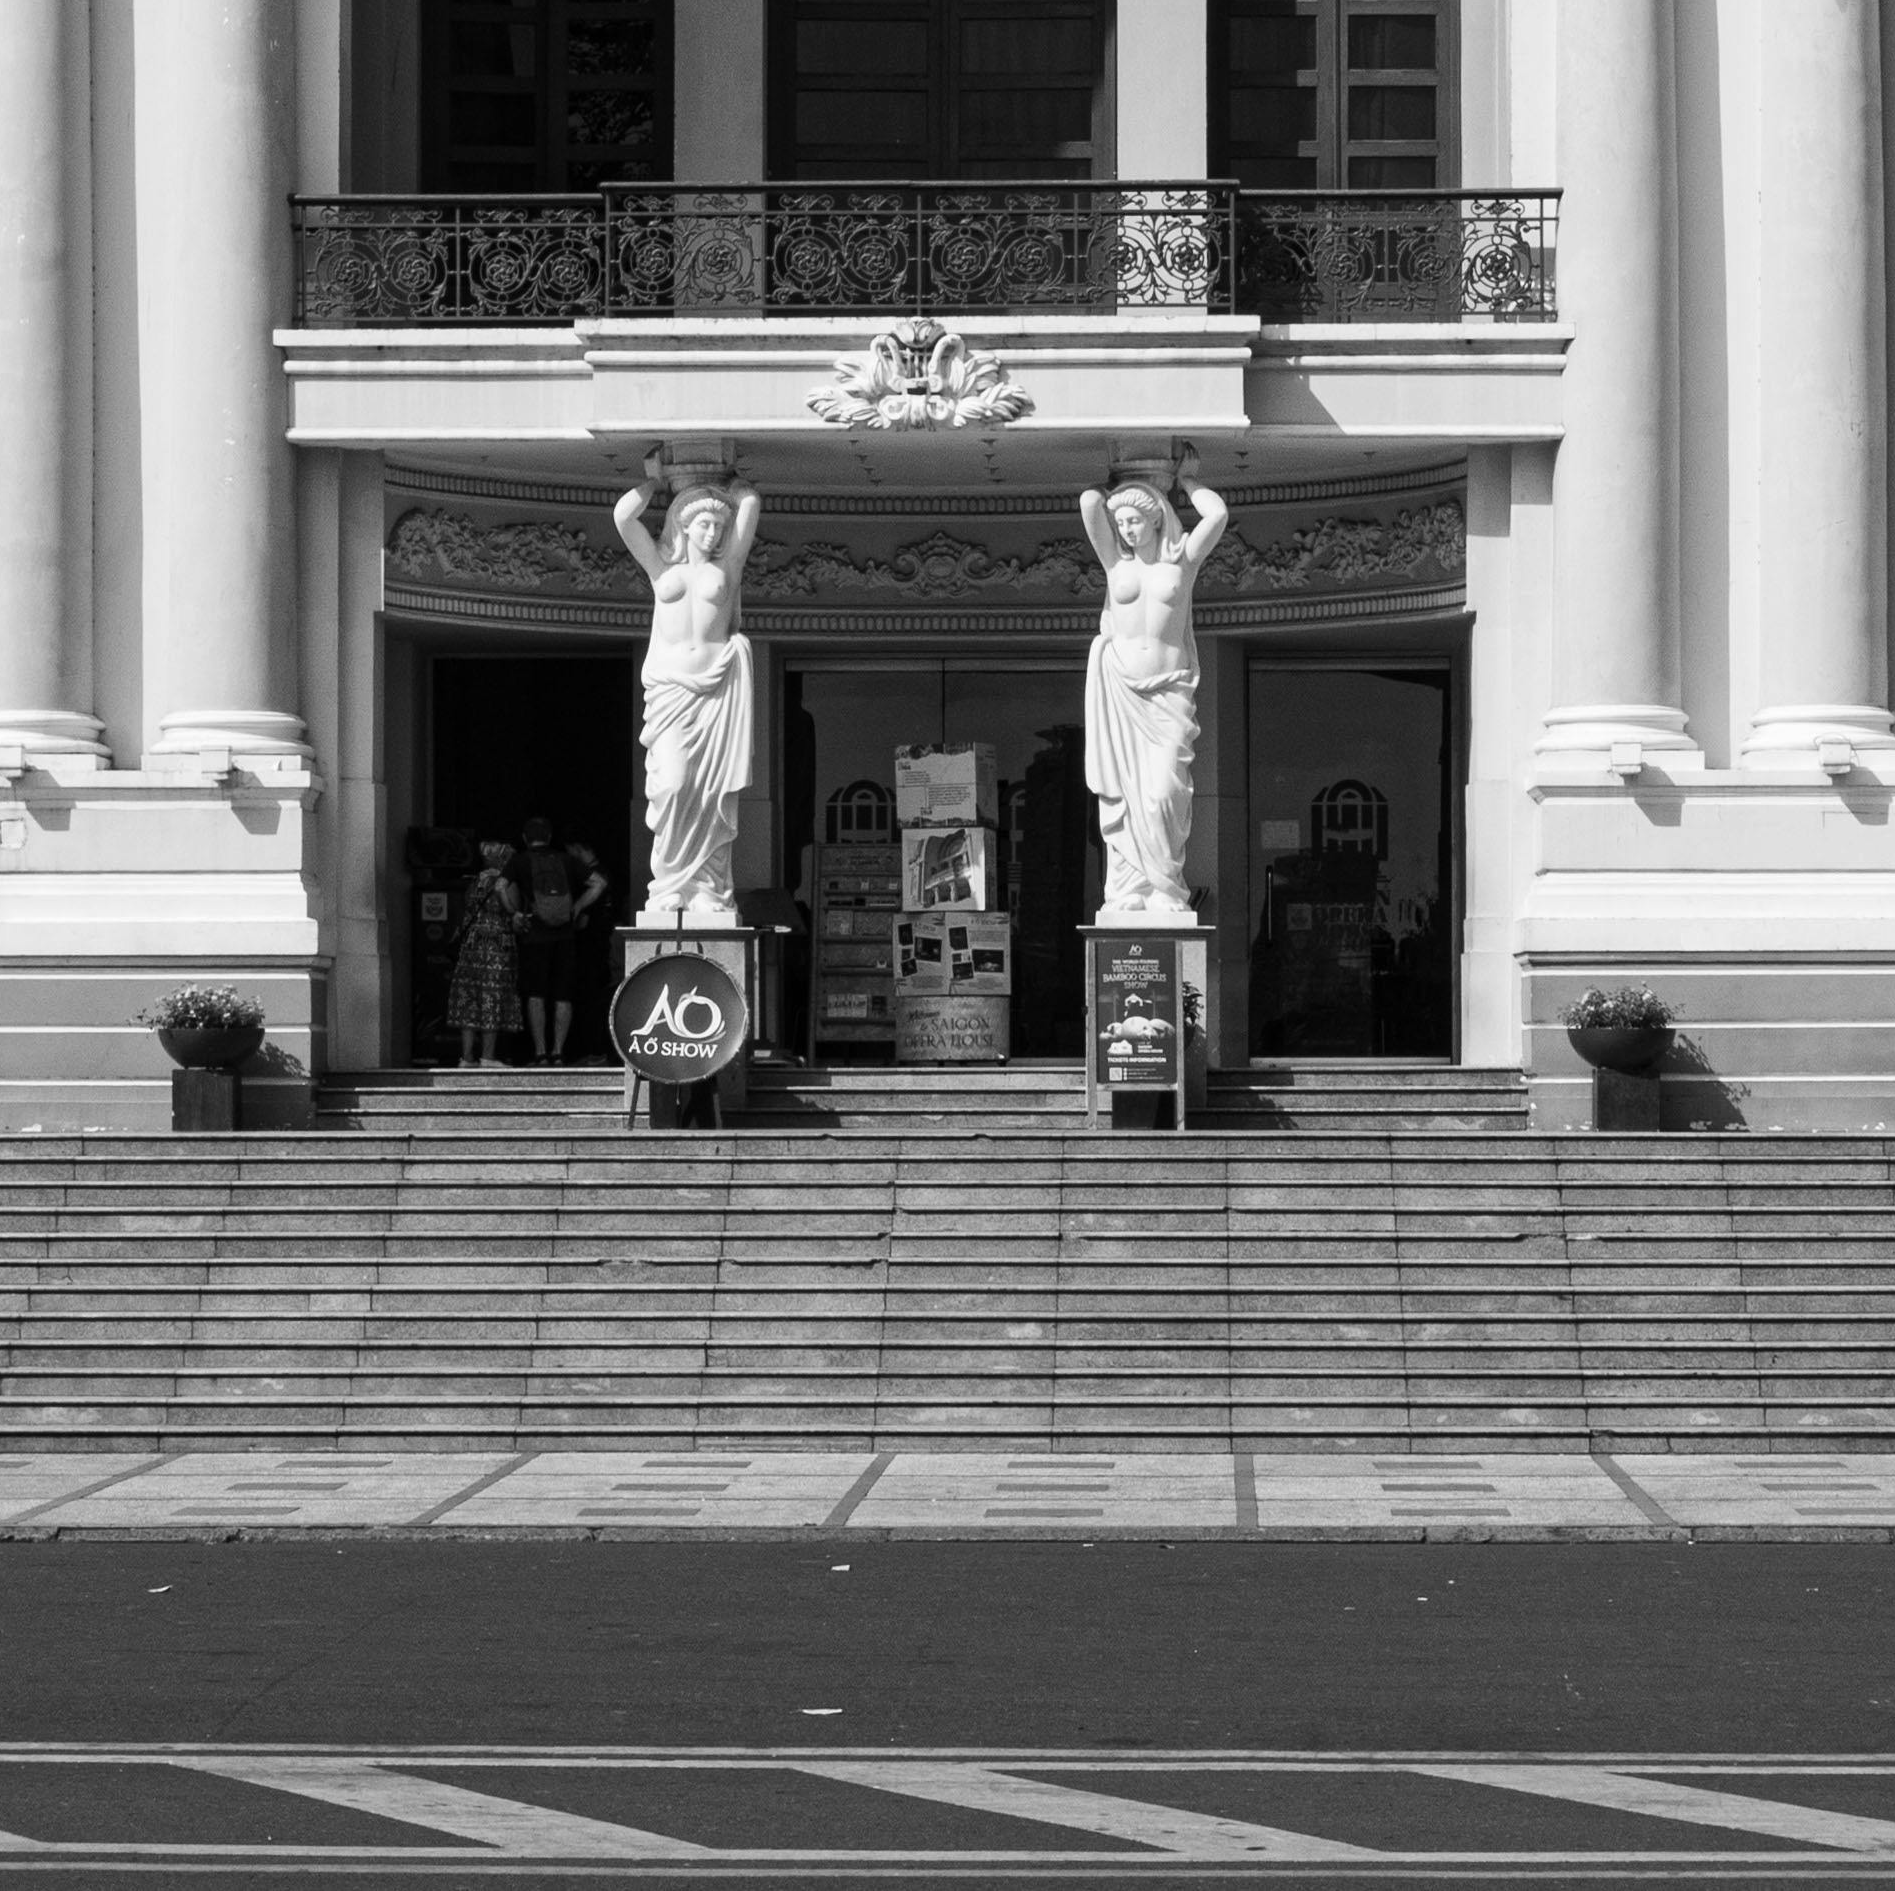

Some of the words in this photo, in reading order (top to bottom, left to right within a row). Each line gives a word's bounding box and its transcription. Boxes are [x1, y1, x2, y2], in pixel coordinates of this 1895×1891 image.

[1111, 964, 1161, 973] VIETNAMESE
[1103, 972, 1138, 983] BAMBOO
[1139, 972, 1167, 983] CIRCUS
[1124, 981, 1149, 990] SHOW
[930, 1017, 990, 1031] SAIGON
[660, 1041, 718, 1058] SHOW
